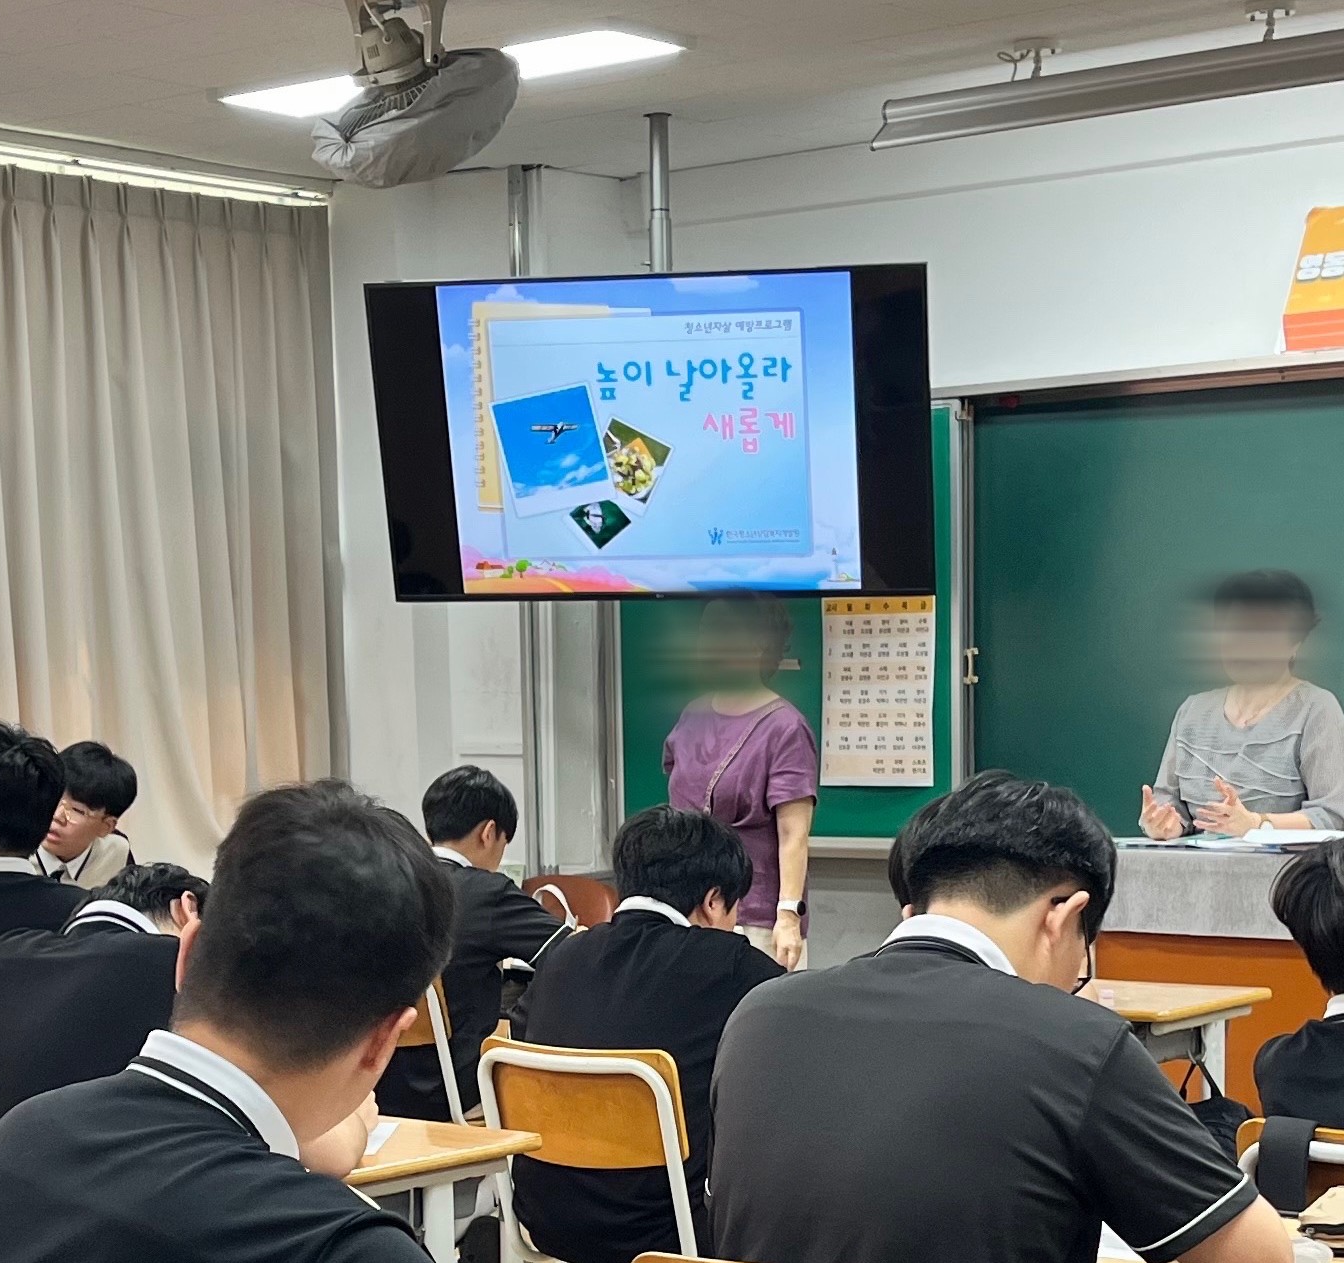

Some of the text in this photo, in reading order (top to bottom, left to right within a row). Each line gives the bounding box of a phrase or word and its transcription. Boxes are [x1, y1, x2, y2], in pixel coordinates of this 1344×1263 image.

[684, 319, 793, 335] 청소년자살 예방프로그램
[595, 352, 793, 402] 높이 날아올라
[702, 407, 794, 454] 새롭게
